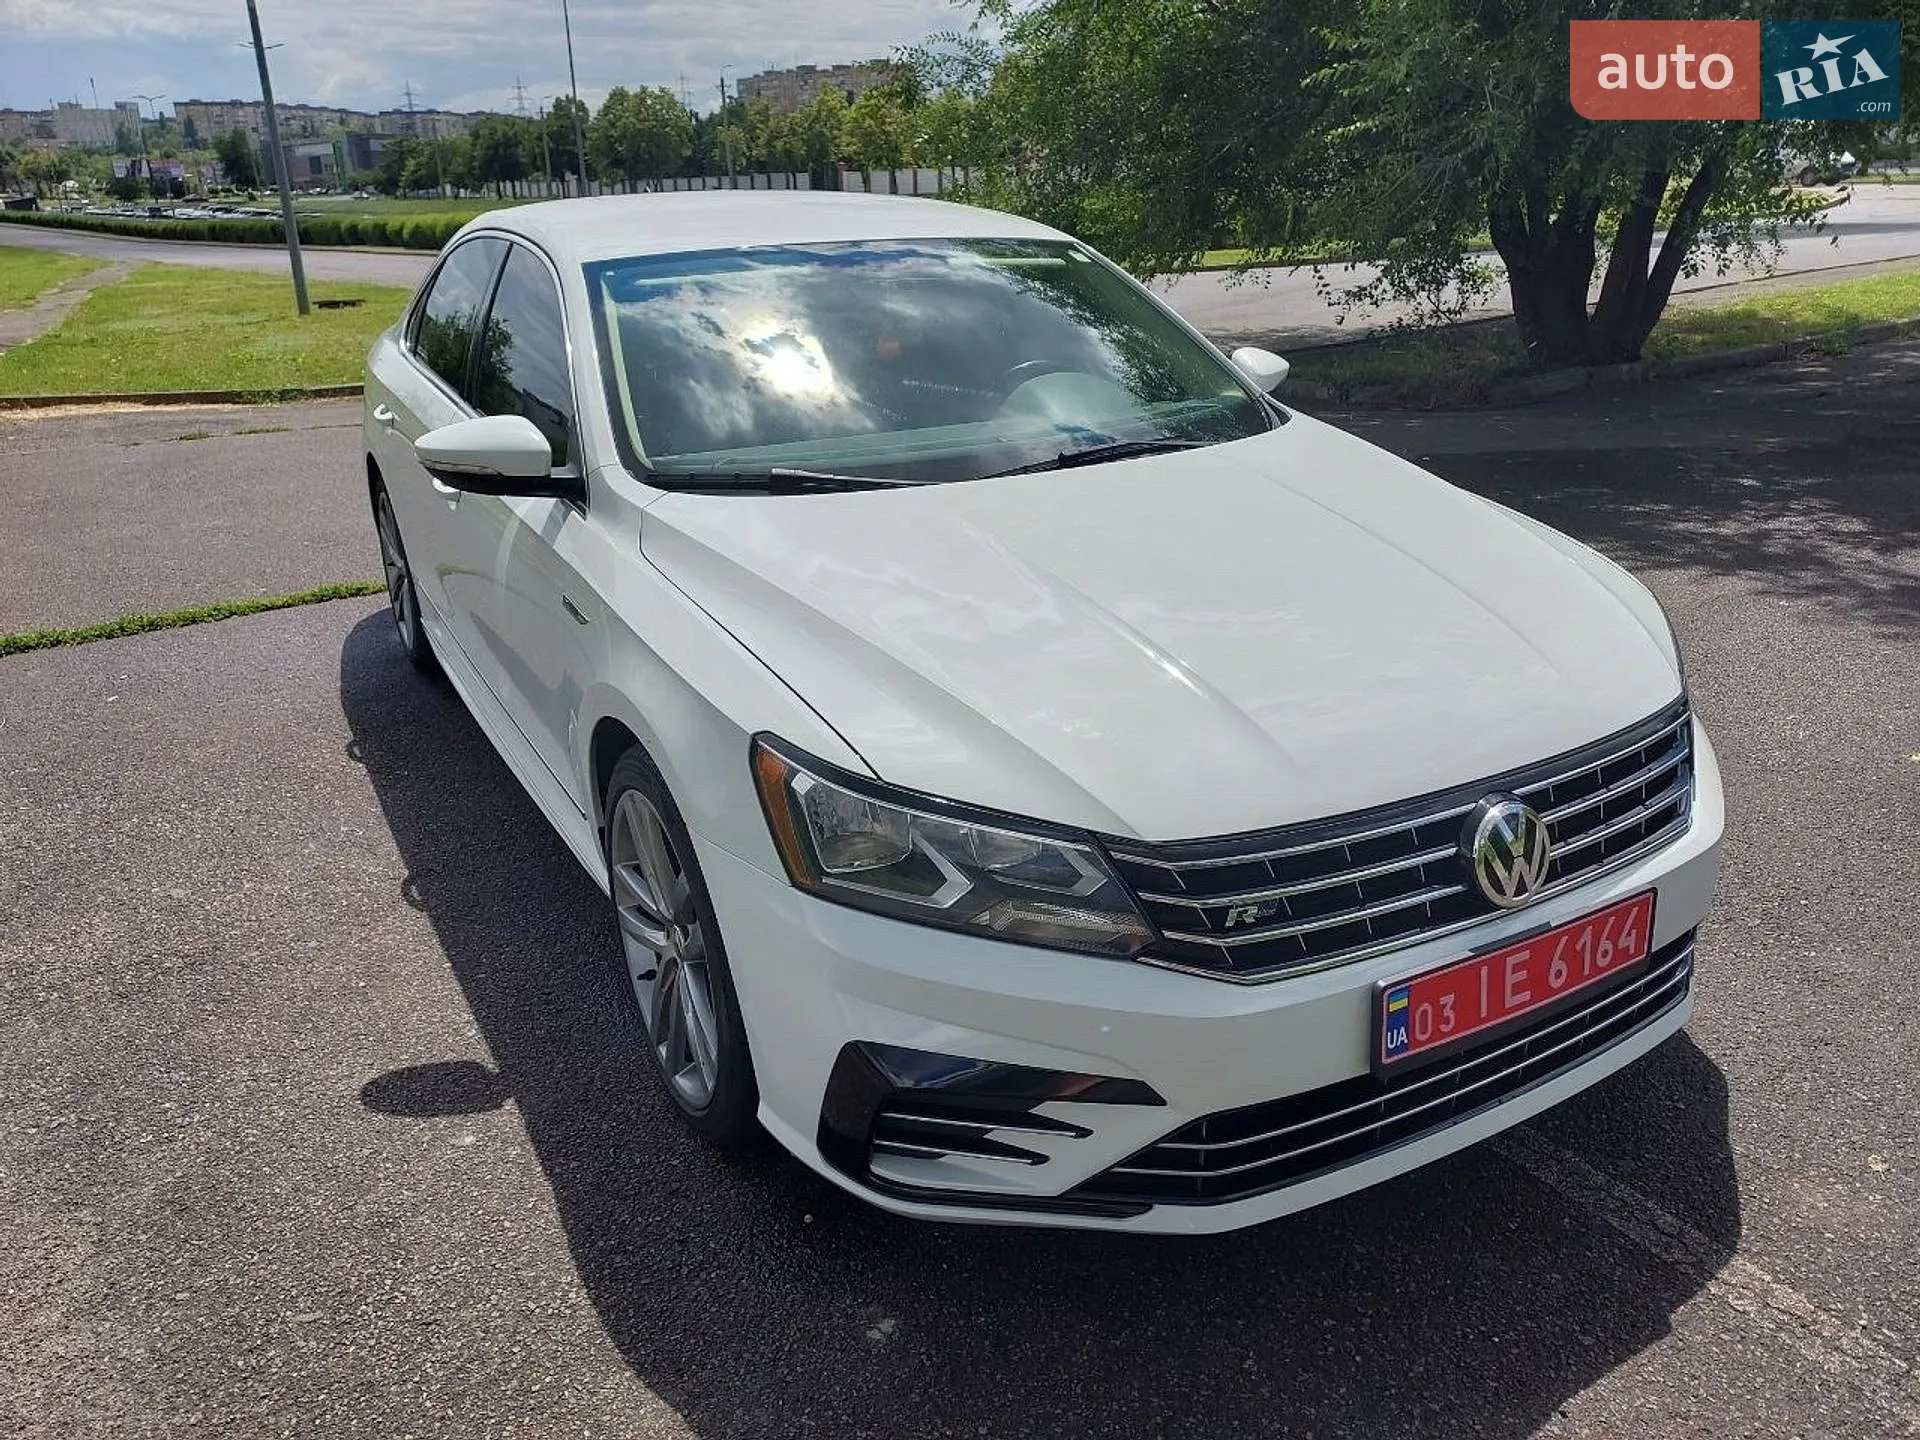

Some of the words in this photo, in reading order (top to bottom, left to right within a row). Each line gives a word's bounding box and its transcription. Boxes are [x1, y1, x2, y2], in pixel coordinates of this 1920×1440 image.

[1414, 992, 1456, 1042] 03
[1479, 949, 1532, 1019] IE
[1547, 906, 1640, 990] 6164
[1386, 1026, 1409, 1050] UA
